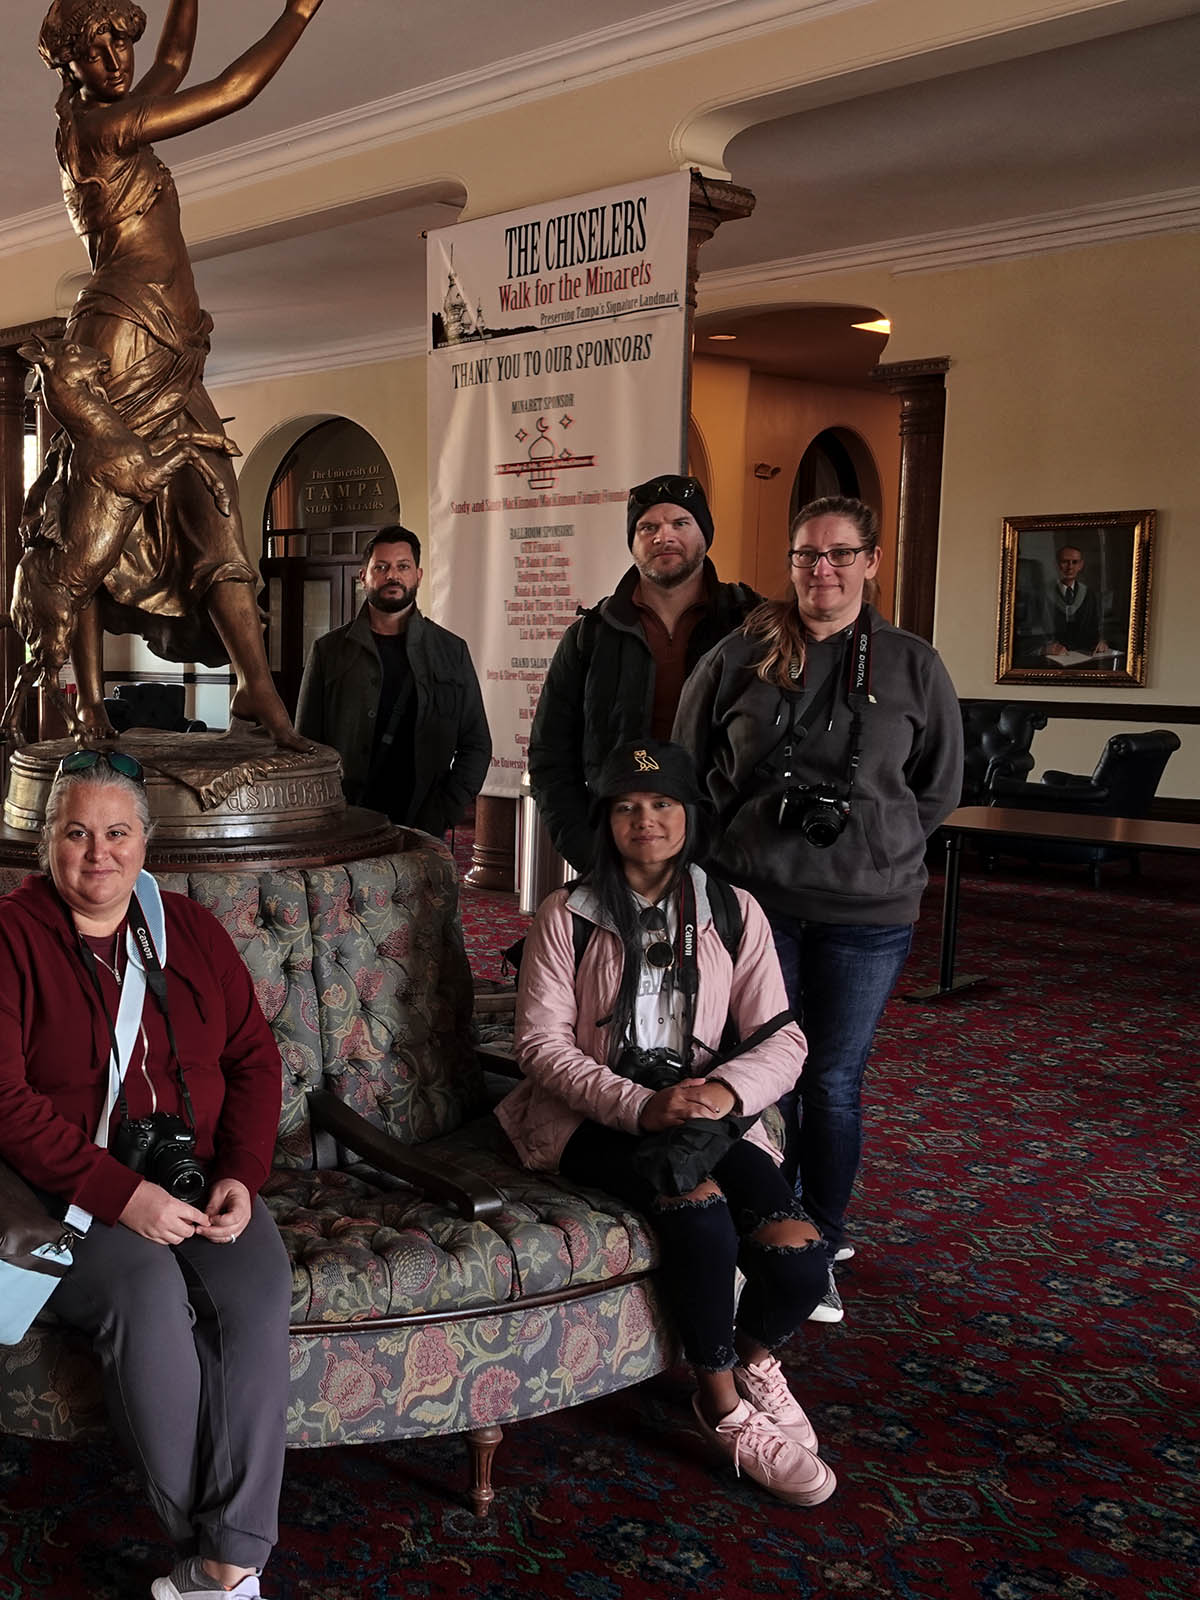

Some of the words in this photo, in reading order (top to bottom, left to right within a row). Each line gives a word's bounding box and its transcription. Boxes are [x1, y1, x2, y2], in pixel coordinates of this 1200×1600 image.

[505, 221, 541, 280] THE
[545, 196, 648, 271] CHISELERS
[499, 282, 530, 312] Walk
[535, 278, 555, 306] for
[559, 274, 581, 301] the
[585, 259, 651, 297] Minarets
[540, 309, 575, 325] Preserving
[576, 305, 605, 320] Tampa's
[606, 298, 638, 316] Signature
[639, 290, 679, 308] Landmark
[452, 357, 493, 389] THANK
[496, 352, 521, 382] YOU
[523, 350, 541, 377] TO
[545, 344, 573, 374] OUR
[575, 334, 653, 370] SPONSORS
[511, 397, 542, 414] MINARET
[543, 393, 575, 410] SPONSOR
[312, 471, 325, 479] The
[328, 466, 367, 478] University
[369, 465, 380, 474] Of
[305, 503, 343, 513] STUDENT
[346, 501, 384, 512] AFFAIRS
[306, 482, 382, 500] TAMPA
[860, 633, 868, 652] EOS
[857, 654, 866, 687] DIGITAL
[137, 927, 154, 959] Canon
[684, 924, 694, 956] Canon
